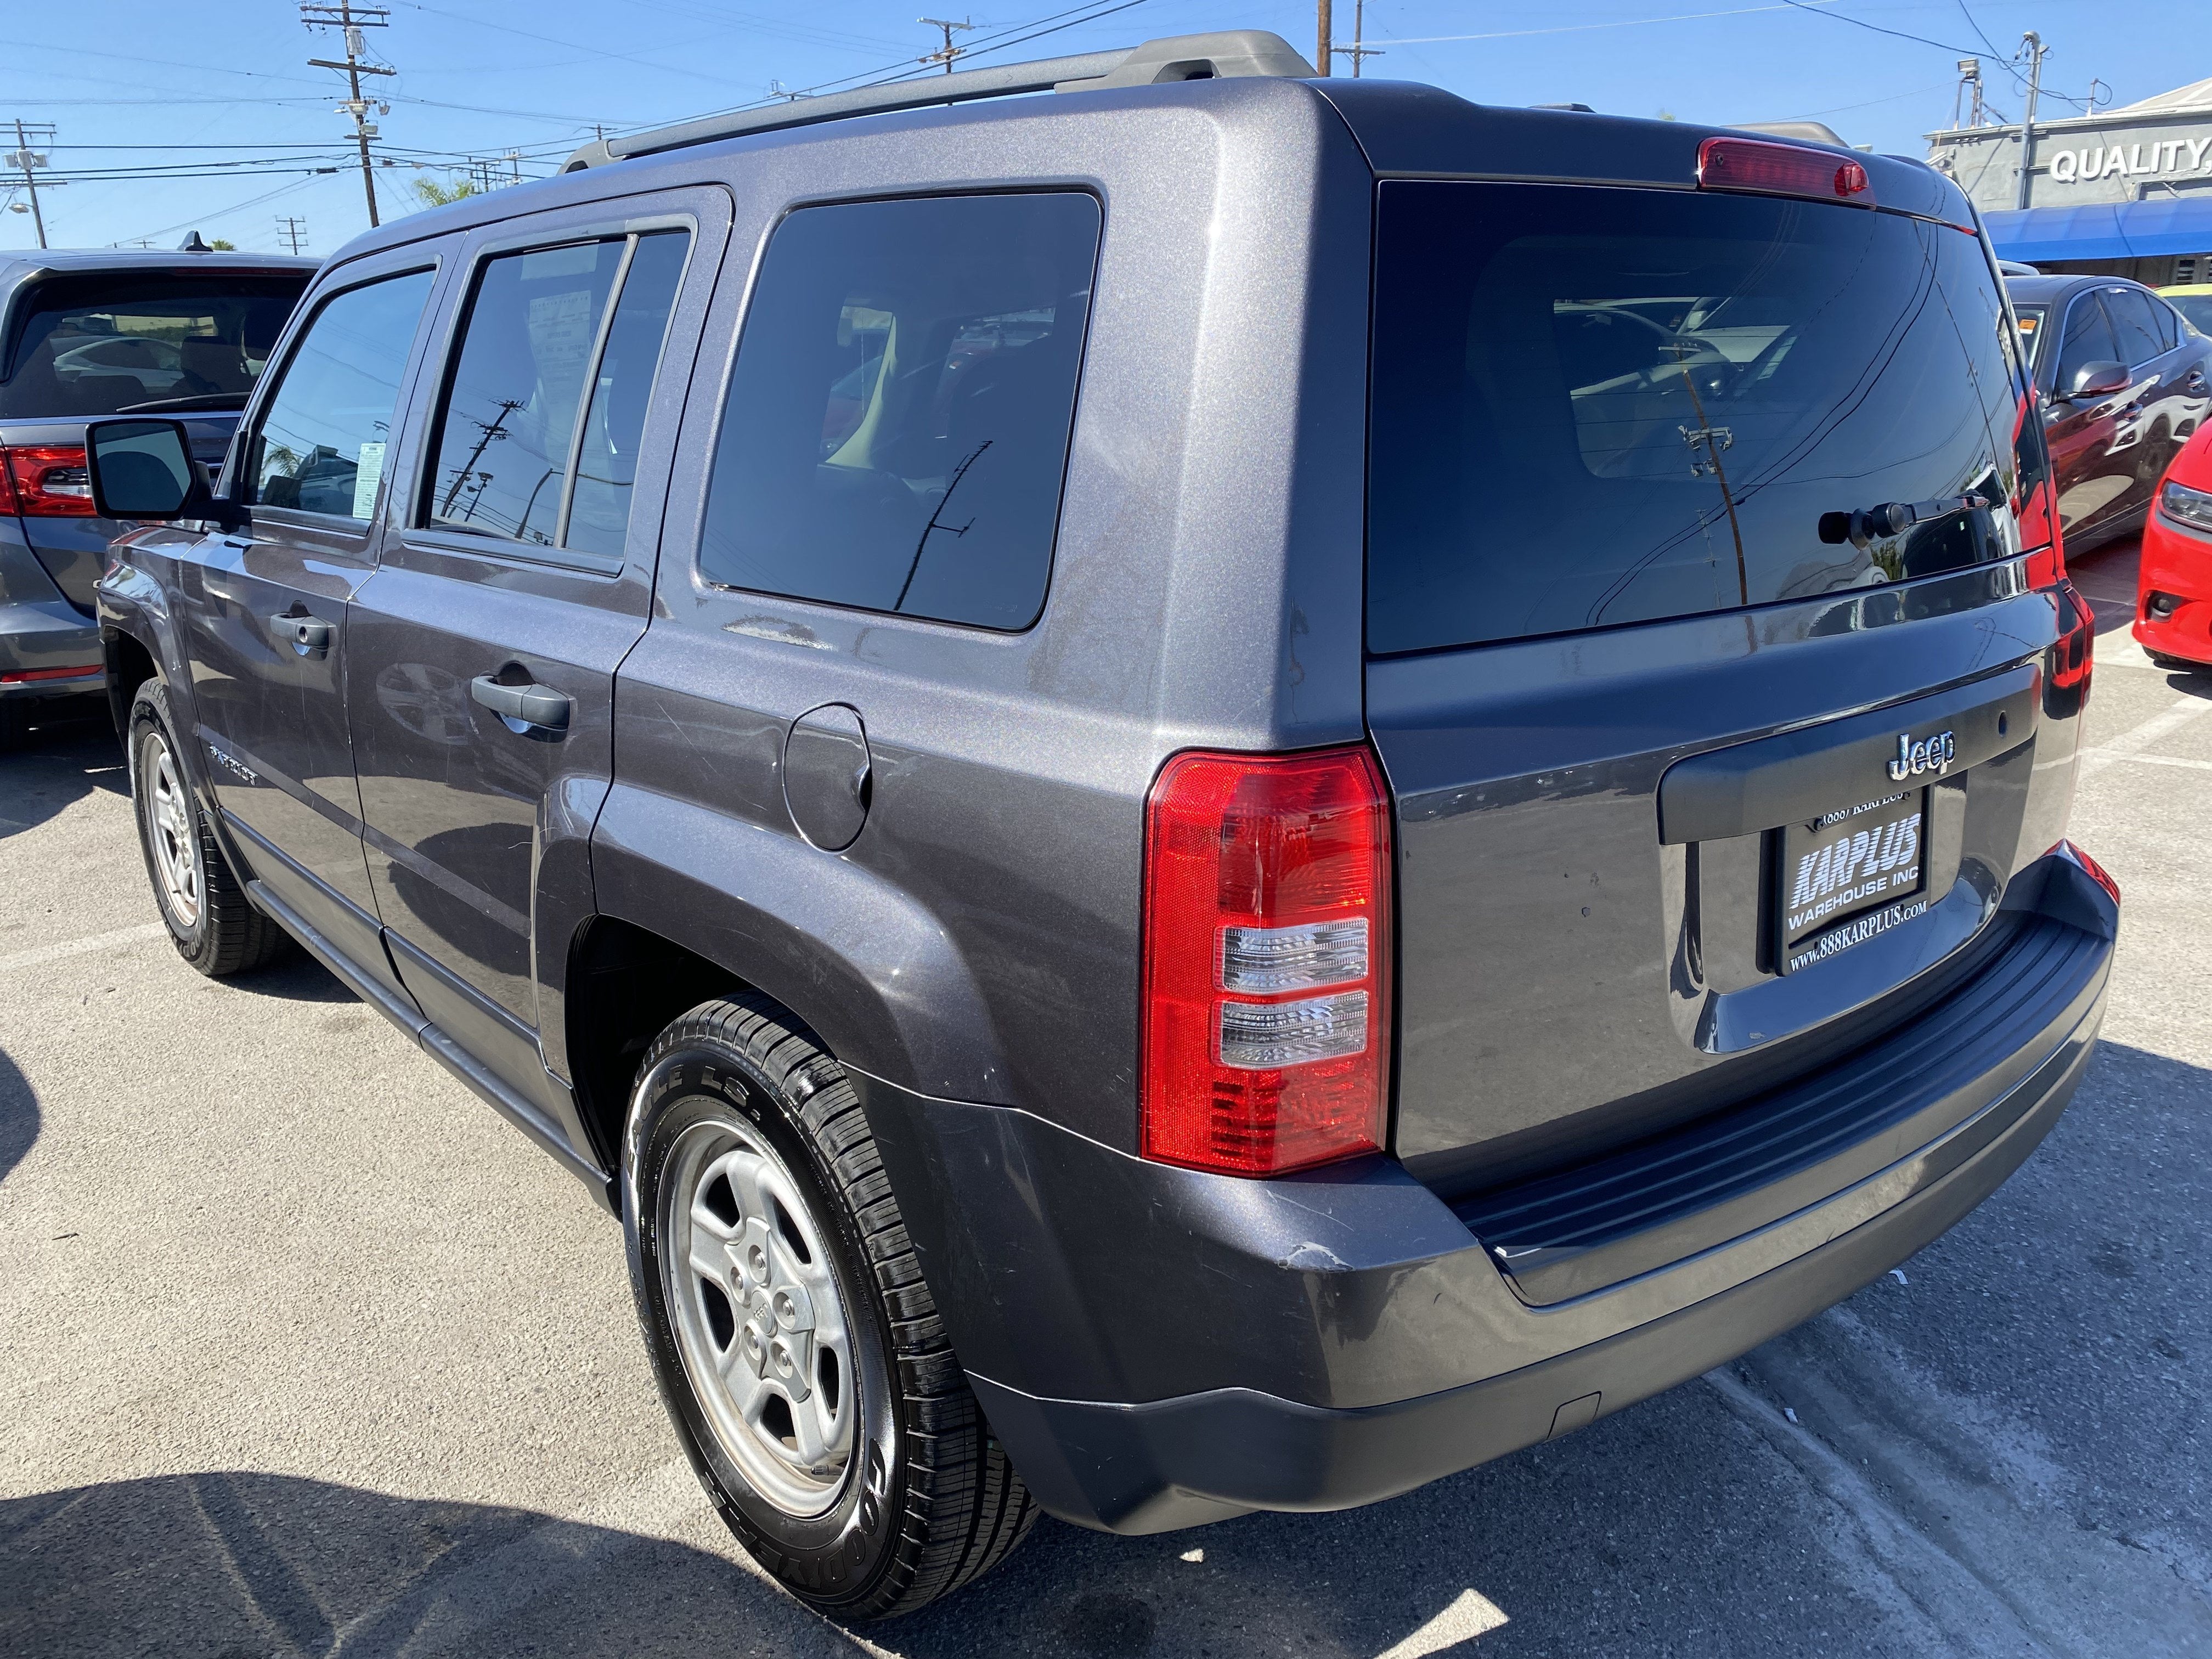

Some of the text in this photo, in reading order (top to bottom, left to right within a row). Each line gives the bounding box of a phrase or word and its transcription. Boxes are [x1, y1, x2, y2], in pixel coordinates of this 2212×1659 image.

[1889, 730, 1956, 781] Jeep
[1788, 813, 1921, 909] KARPLUS
[1788, 865, 1919, 930] WAREHOUSE INC
[699, 1437, 886, 1589] GOODYEAR
